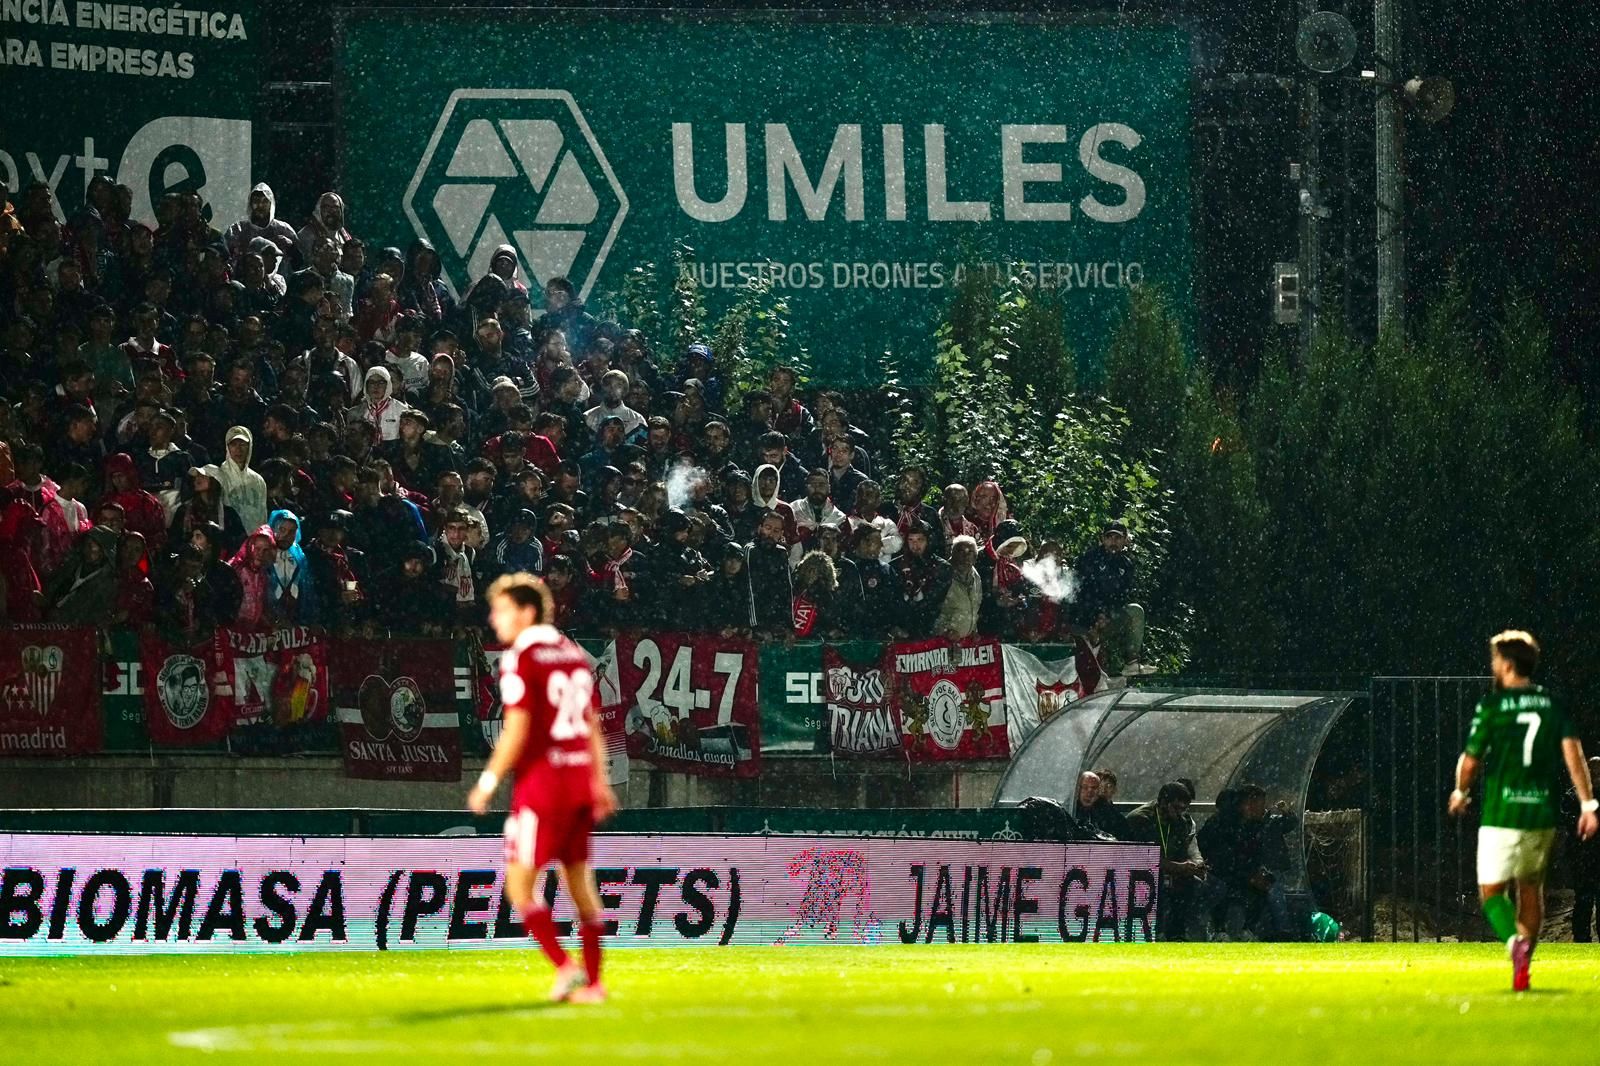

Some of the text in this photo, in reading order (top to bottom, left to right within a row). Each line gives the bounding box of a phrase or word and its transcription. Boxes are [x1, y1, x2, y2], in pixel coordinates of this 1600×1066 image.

[0, 0, 248, 40] NCIA ENERGÉTICA
[51, 42, 196, 80] EMPRESAS
[671, 121, 1147, 224] UMILES
[833, 261, 944, 290] DRONES
[1019, 261, 1145, 291] SERVICIO
[633, 638, 744, 727] 24-7
[1, 725, 67, 750] madrid
[828, 703, 900, 752] TRIANA
[1516, 711, 1541, 767] 7
[350, 740, 449, 763] SANTA JUSTA
[703, 752, 736, 770] away
[0, 867, 347, 943] BIOMASA
[900, 864, 1043, 944] JAIME
[1059, 868, 1157, 944] GAR
